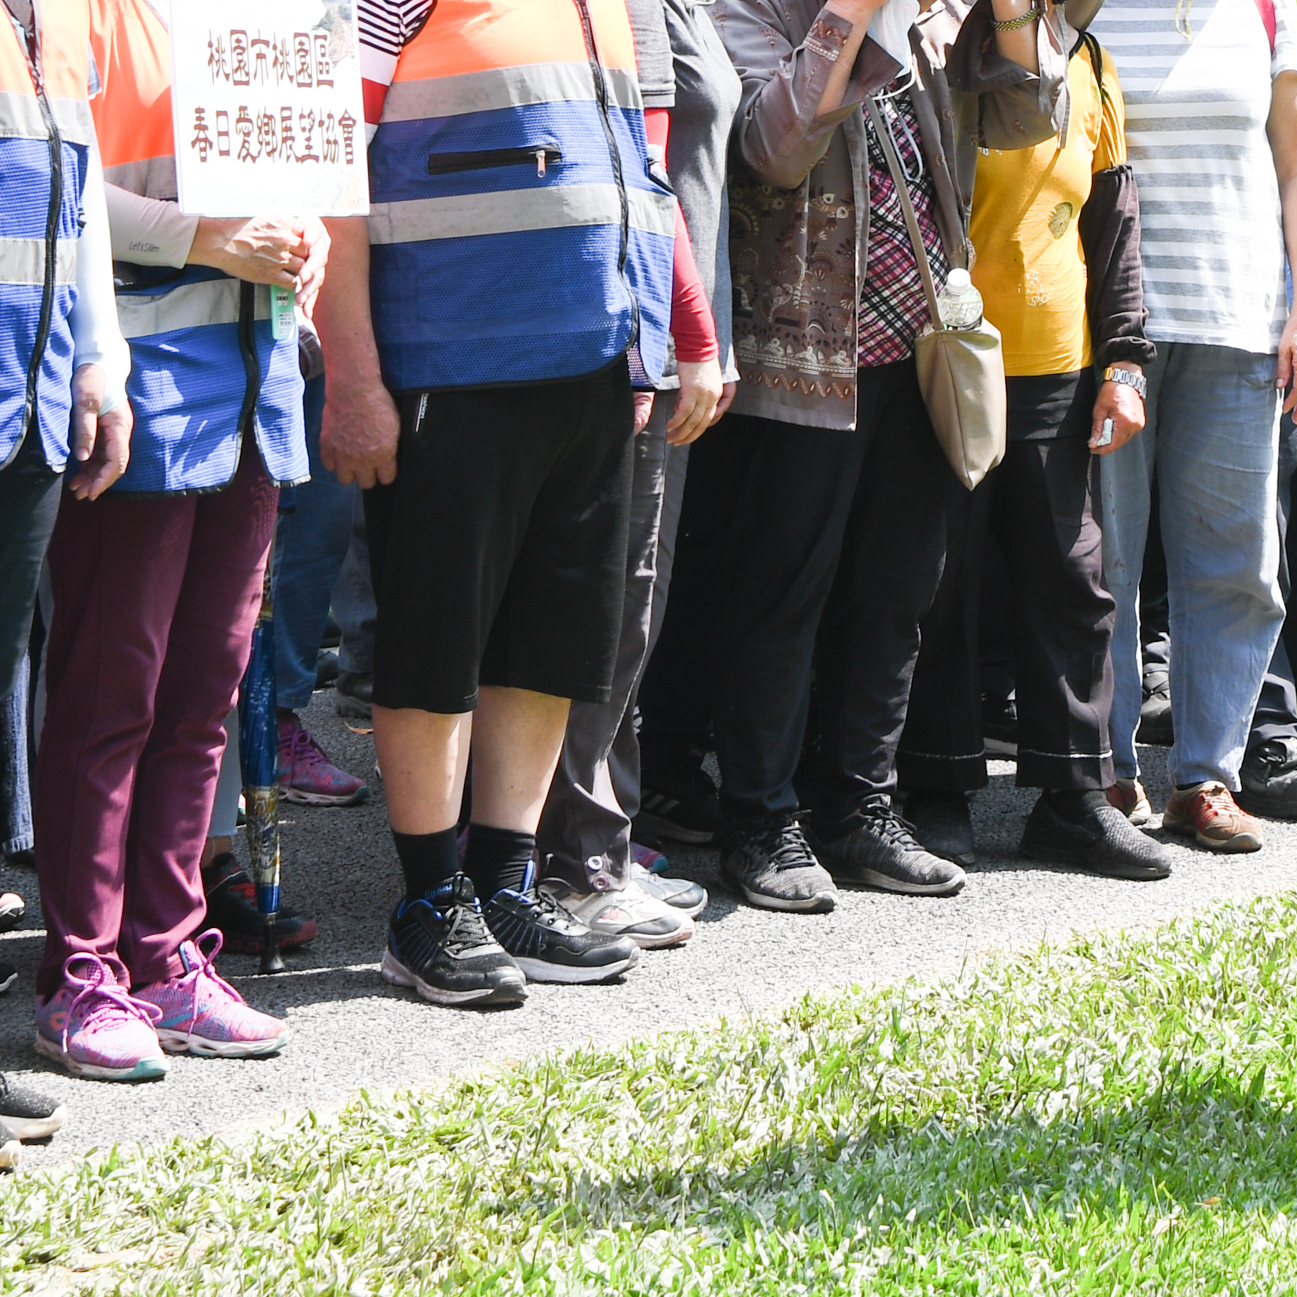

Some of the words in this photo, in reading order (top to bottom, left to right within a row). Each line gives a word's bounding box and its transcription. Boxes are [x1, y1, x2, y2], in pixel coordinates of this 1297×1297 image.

[208, 29, 334, 88] 桃園市桃園區
[191, 105, 356, 165] 春日愛鄉展望協會
